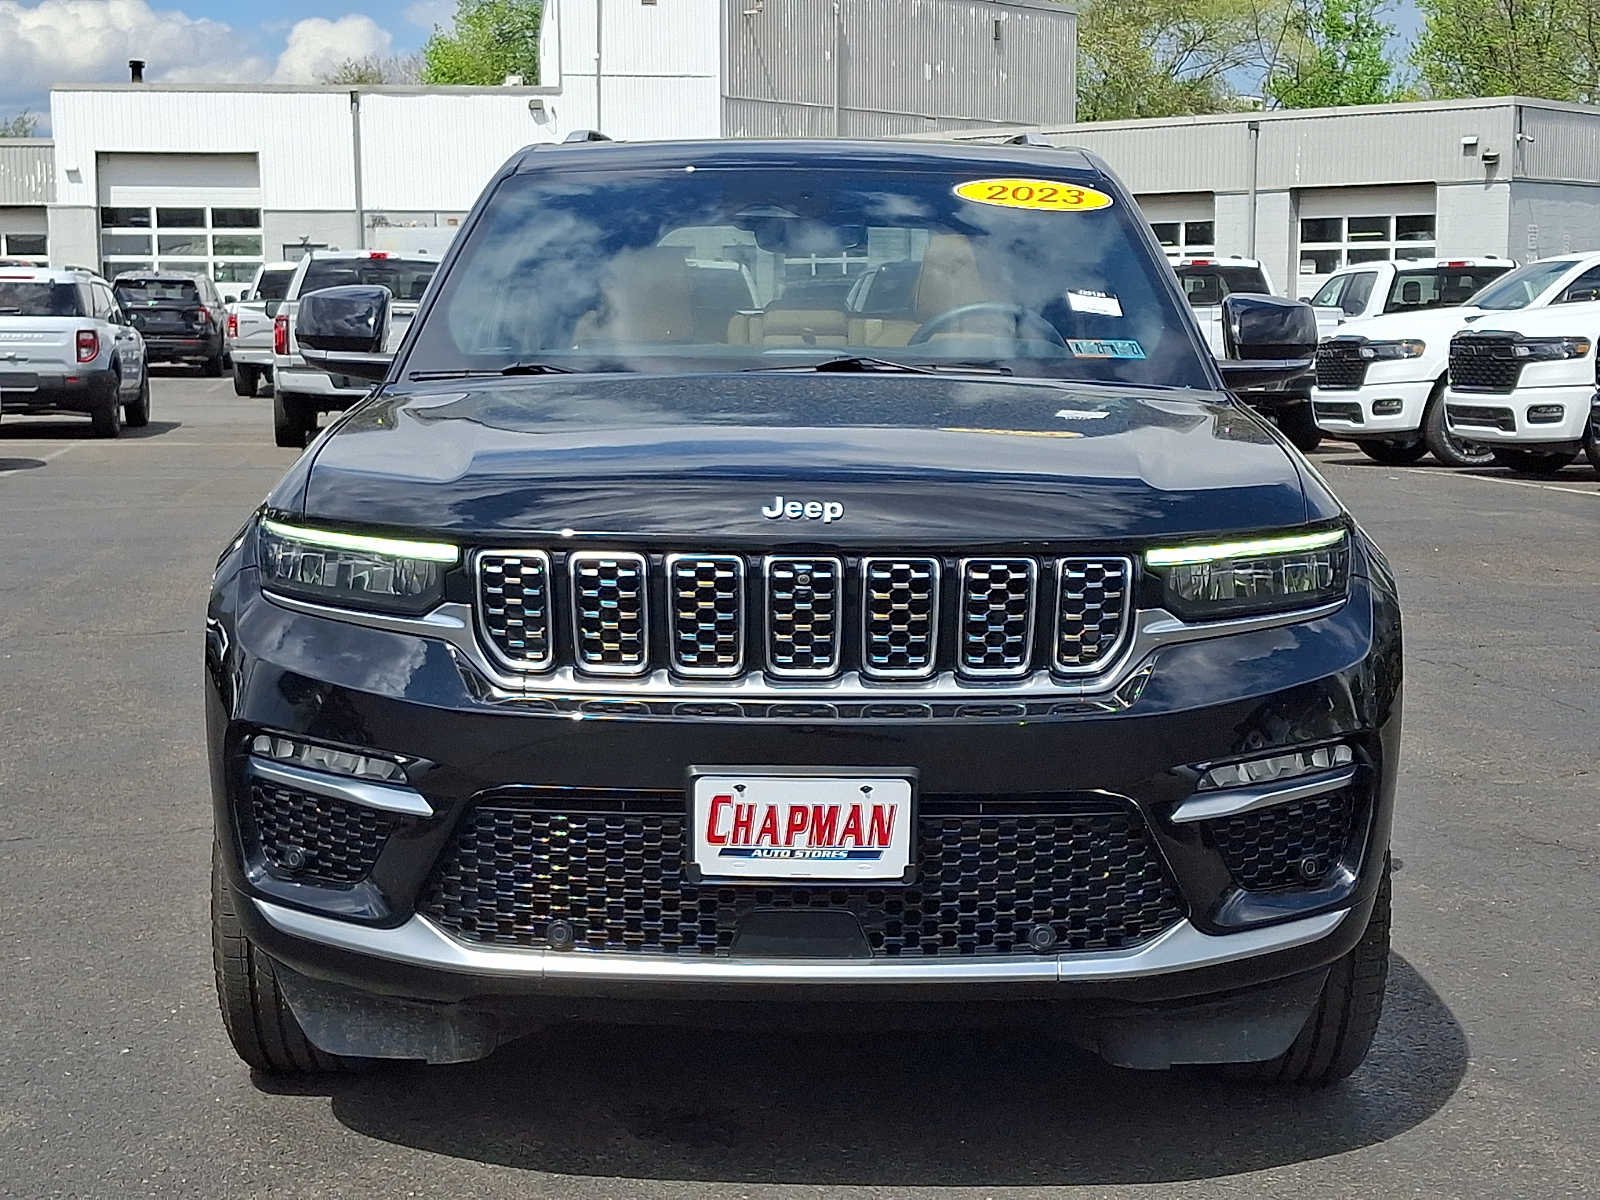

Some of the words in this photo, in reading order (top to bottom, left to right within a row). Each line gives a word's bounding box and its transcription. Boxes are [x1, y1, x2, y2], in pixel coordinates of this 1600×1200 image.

[986, 185, 1085, 205] 2023
[762, 496, 844, 524] Jeep
[706, 795, 897, 848] CHAPMAN
[751, 849, 788, 859] AUTO
[794, 850, 849, 860] STORES
